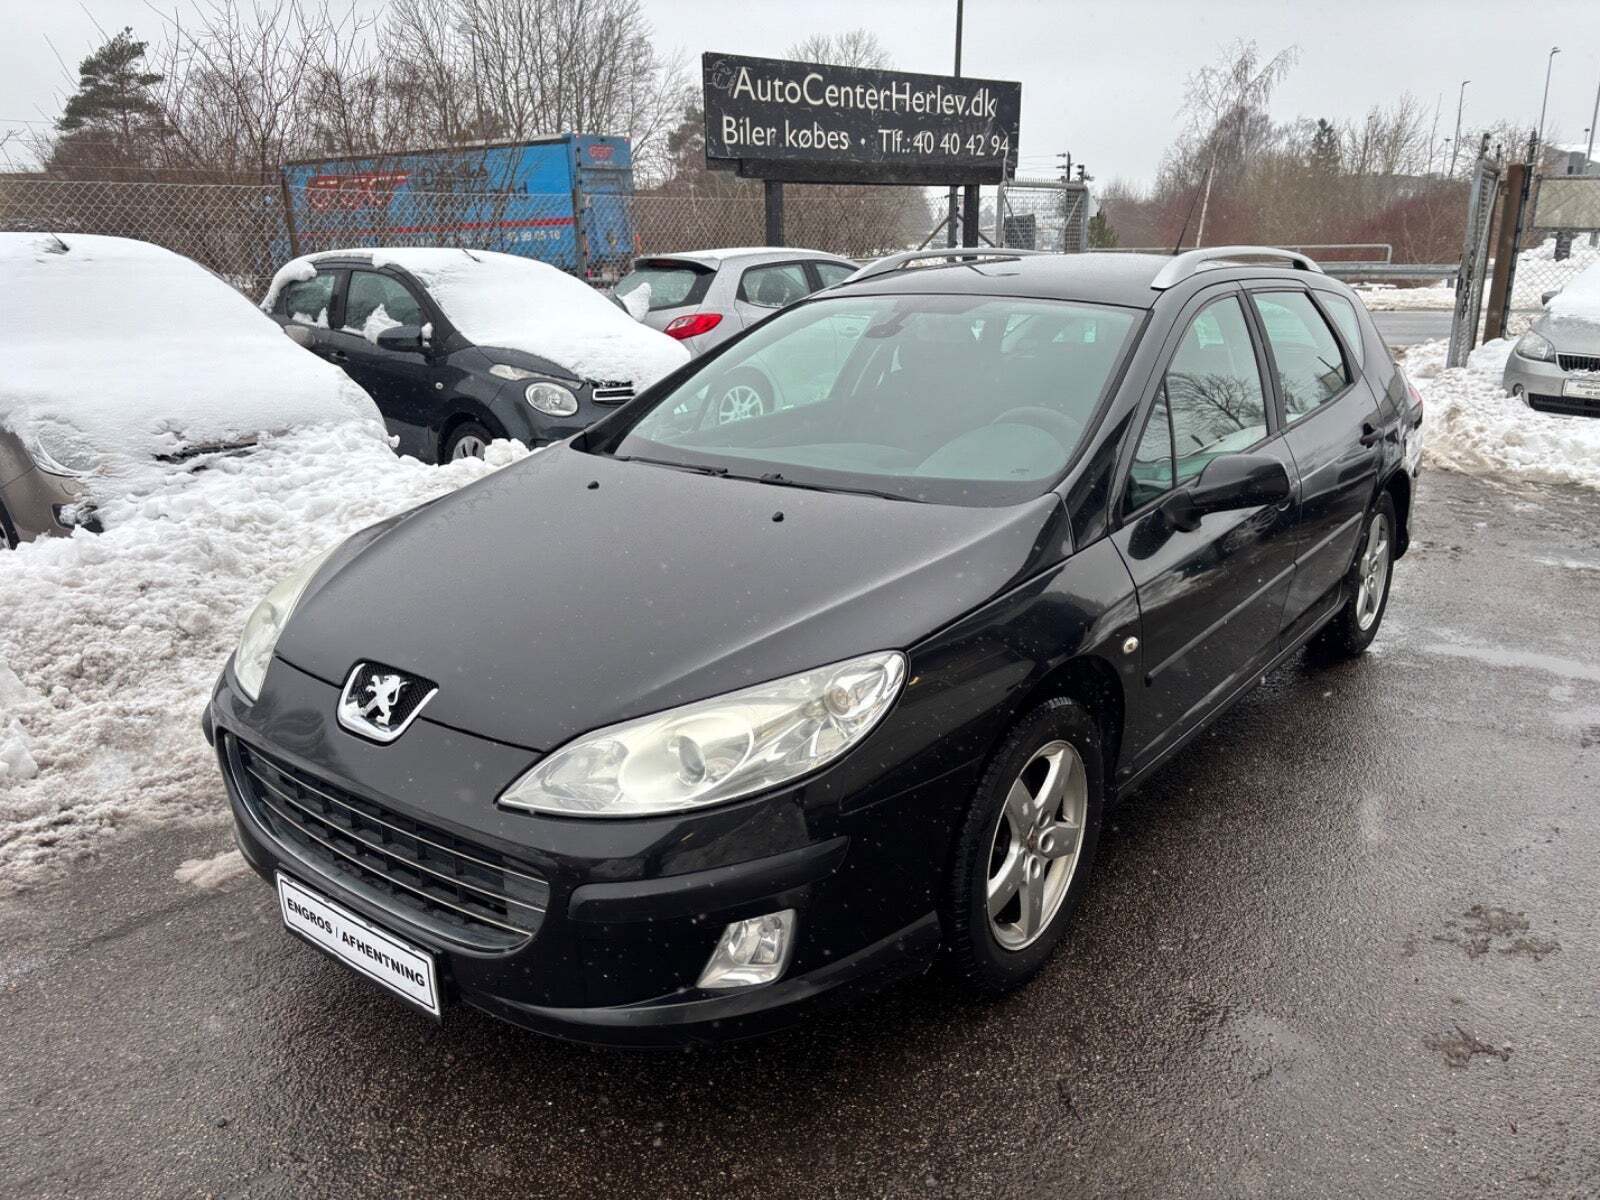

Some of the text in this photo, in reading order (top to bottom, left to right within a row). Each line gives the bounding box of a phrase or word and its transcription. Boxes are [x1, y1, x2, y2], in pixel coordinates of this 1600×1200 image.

[733, 66, 996, 118] AutoCenterHerlev.dk
[722, 115, 777, 147] Biler
[785, 119, 849, 150] købes
[940, 132, 960, 155] 40
[965, 134, 985, 156] 42
[991, 135, 1009, 158] 94
[287, 898, 426, 987] ENGROS AFHENTNING
